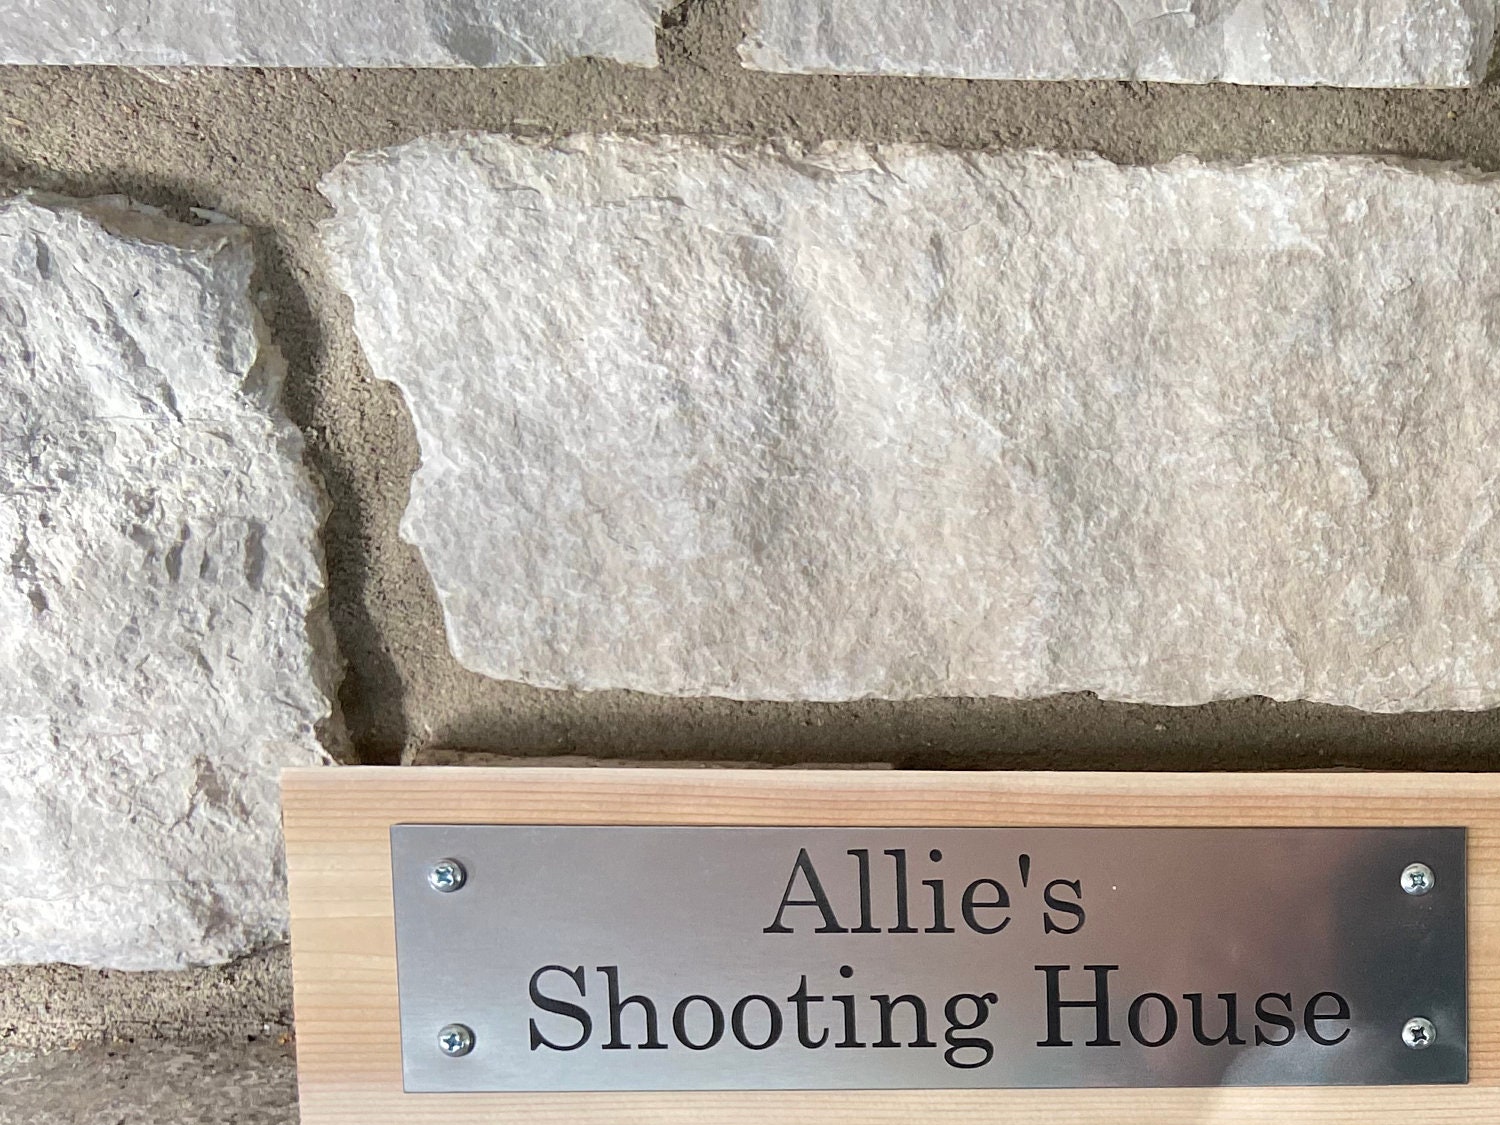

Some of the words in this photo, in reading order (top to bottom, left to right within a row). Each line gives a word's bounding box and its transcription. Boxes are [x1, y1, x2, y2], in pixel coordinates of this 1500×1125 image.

[762, 847, 1086, 937] Allie's
[528, 963, 998, 1069] Shooting
[1034, 964, 1353, 1050] House
